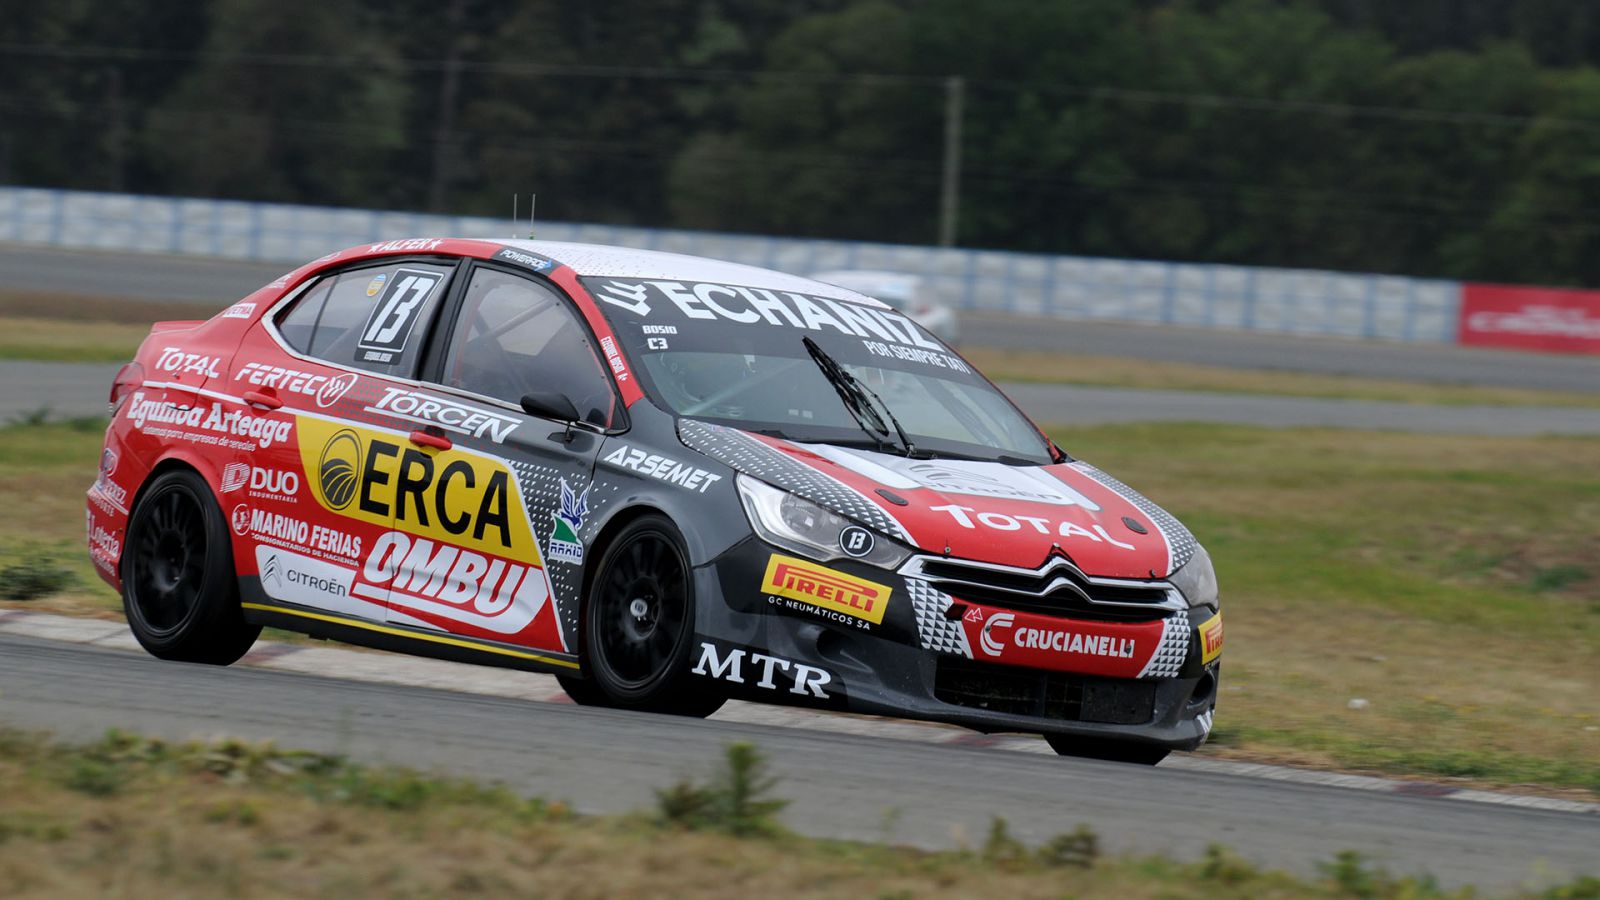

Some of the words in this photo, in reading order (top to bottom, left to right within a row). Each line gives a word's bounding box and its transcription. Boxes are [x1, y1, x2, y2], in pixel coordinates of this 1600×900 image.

[364, 276, 434, 343] 13
[642, 325, 678, 334] BOSIO
[645, 281, 945, 352] ECHANIZ
[156, 347, 220, 377] TOTAL
[647, 338, 668, 350] C3
[863, 340, 894, 358] POR
[889, 344, 947, 368] SIEMPRE
[235, 363, 326, 395] FERTEC
[202, 402, 293, 449] Arteaga
[250, 467, 299, 496] DUO
[603, 445, 722, 493] ARSEMET
[359, 440, 512, 548] ERCA
[250, 508, 309, 545] MARINO
[310, 525, 362, 558] FERIAS
[849, 532, 864, 549] 13
[930, 503, 1136, 551] TOTAL
[286, 569, 346, 597] CITROËN
[362, 532, 524, 613] OMBU
[772, 563, 878, 613] PIRELLI
[768, 596, 782, 606] GC
[785, 600, 853, 626] NEUMÁTICOS
[856, 621, 871, 631] SA
[1014, 627, 1136, 659] CRUCIANELLI
[691, 642, 831, 699] MTR
